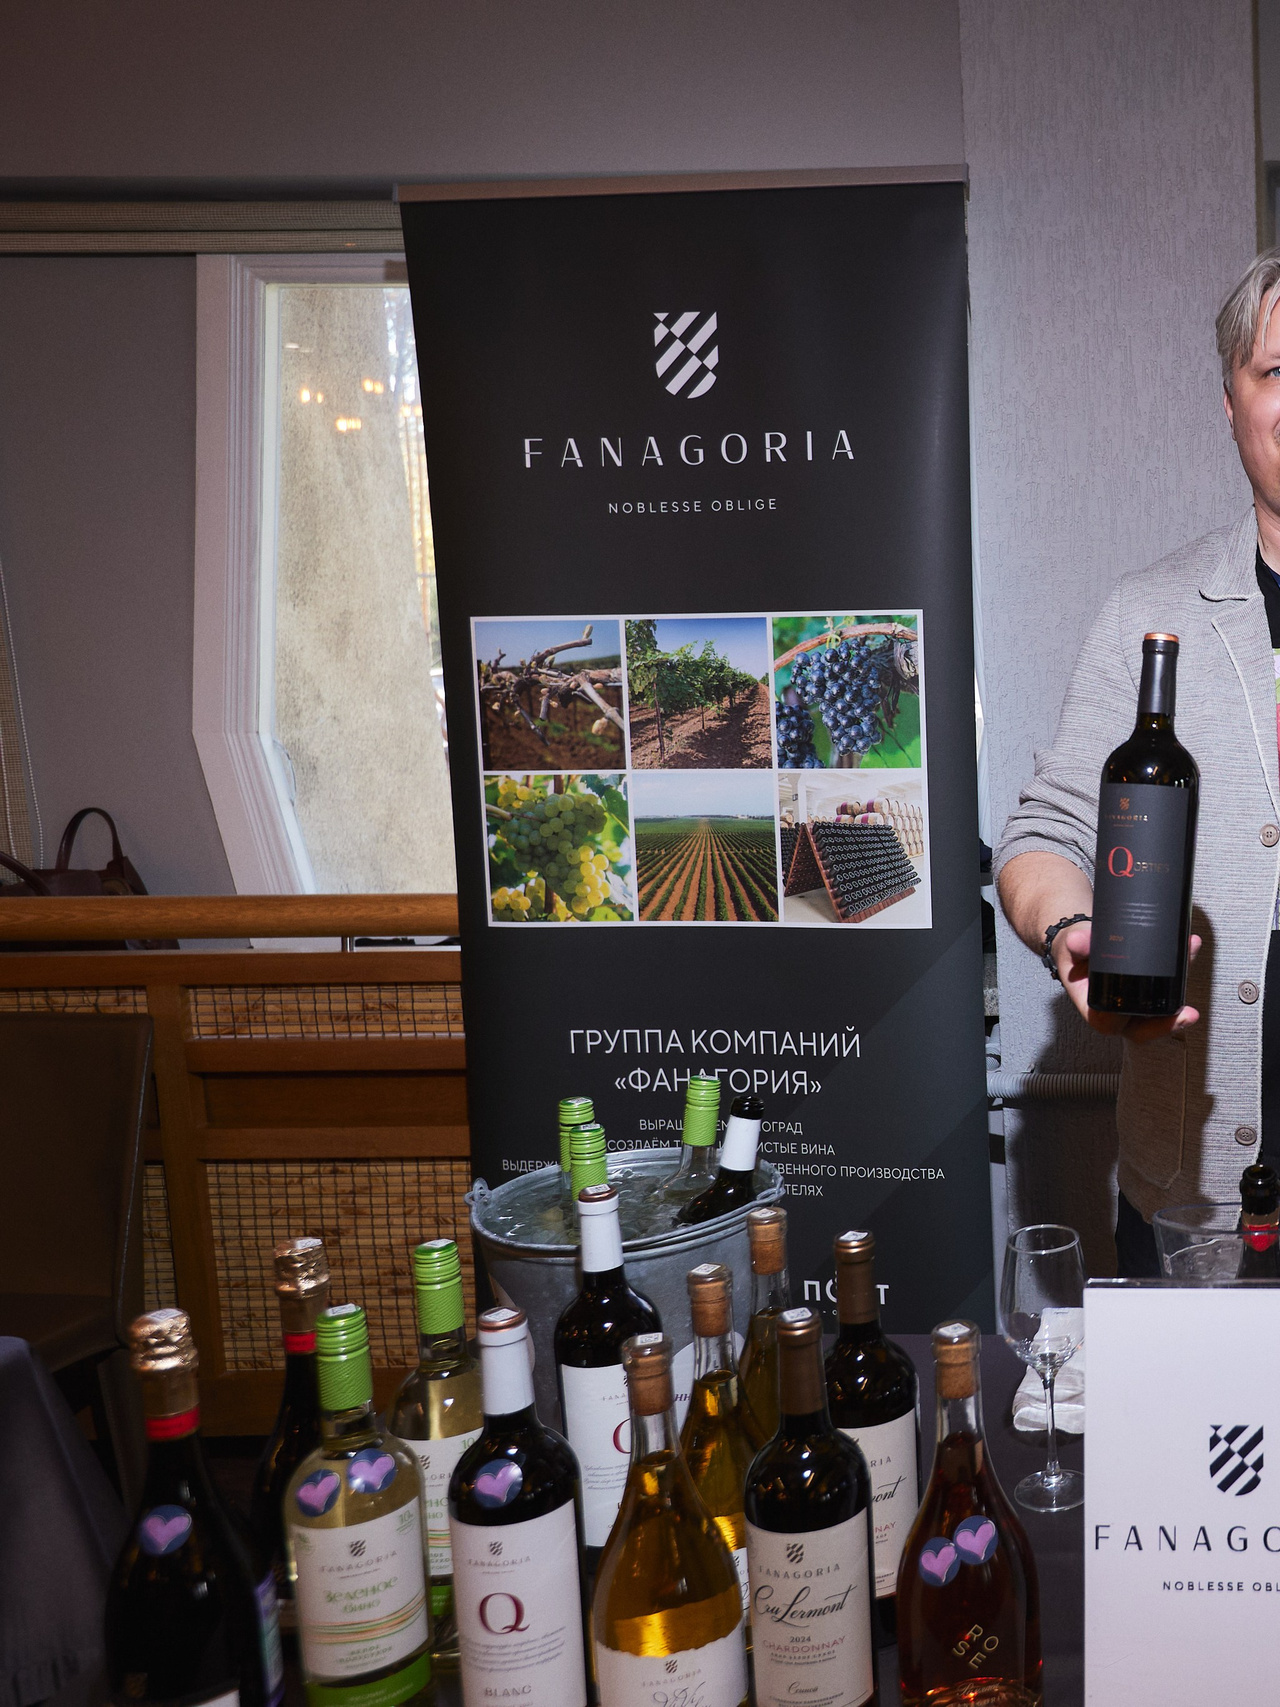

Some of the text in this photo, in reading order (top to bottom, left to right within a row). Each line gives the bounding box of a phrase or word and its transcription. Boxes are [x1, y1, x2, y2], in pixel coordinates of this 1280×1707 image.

[525, 430, 855, 468] FANAGORIA
[609, 498, 777, 514] NOBLESSE OBLIGE
[570, 1025, 861, 1058] ГРУППА КОМПАНИЙ
[801, 1143, 836, 1156] ВИНА
[840, 1165, 945, 1181] ПРОИЗВОДСТВА
[784, 1183, 824, 1197] ТЕЛЯХ
[759, 1563, 841, 1579] FANAGORIA
[1163, 1581, 1245, 1592] NOBLESSE
[480, 1592, 530, 1634] Q
[754, 1585, 782, 1614] Cru
[771, 1584, 858, 1628] Lermont
[763, 1635, 846, 1653] CHARDONNAY
[484, 1684, 532, 1698] BLANC
